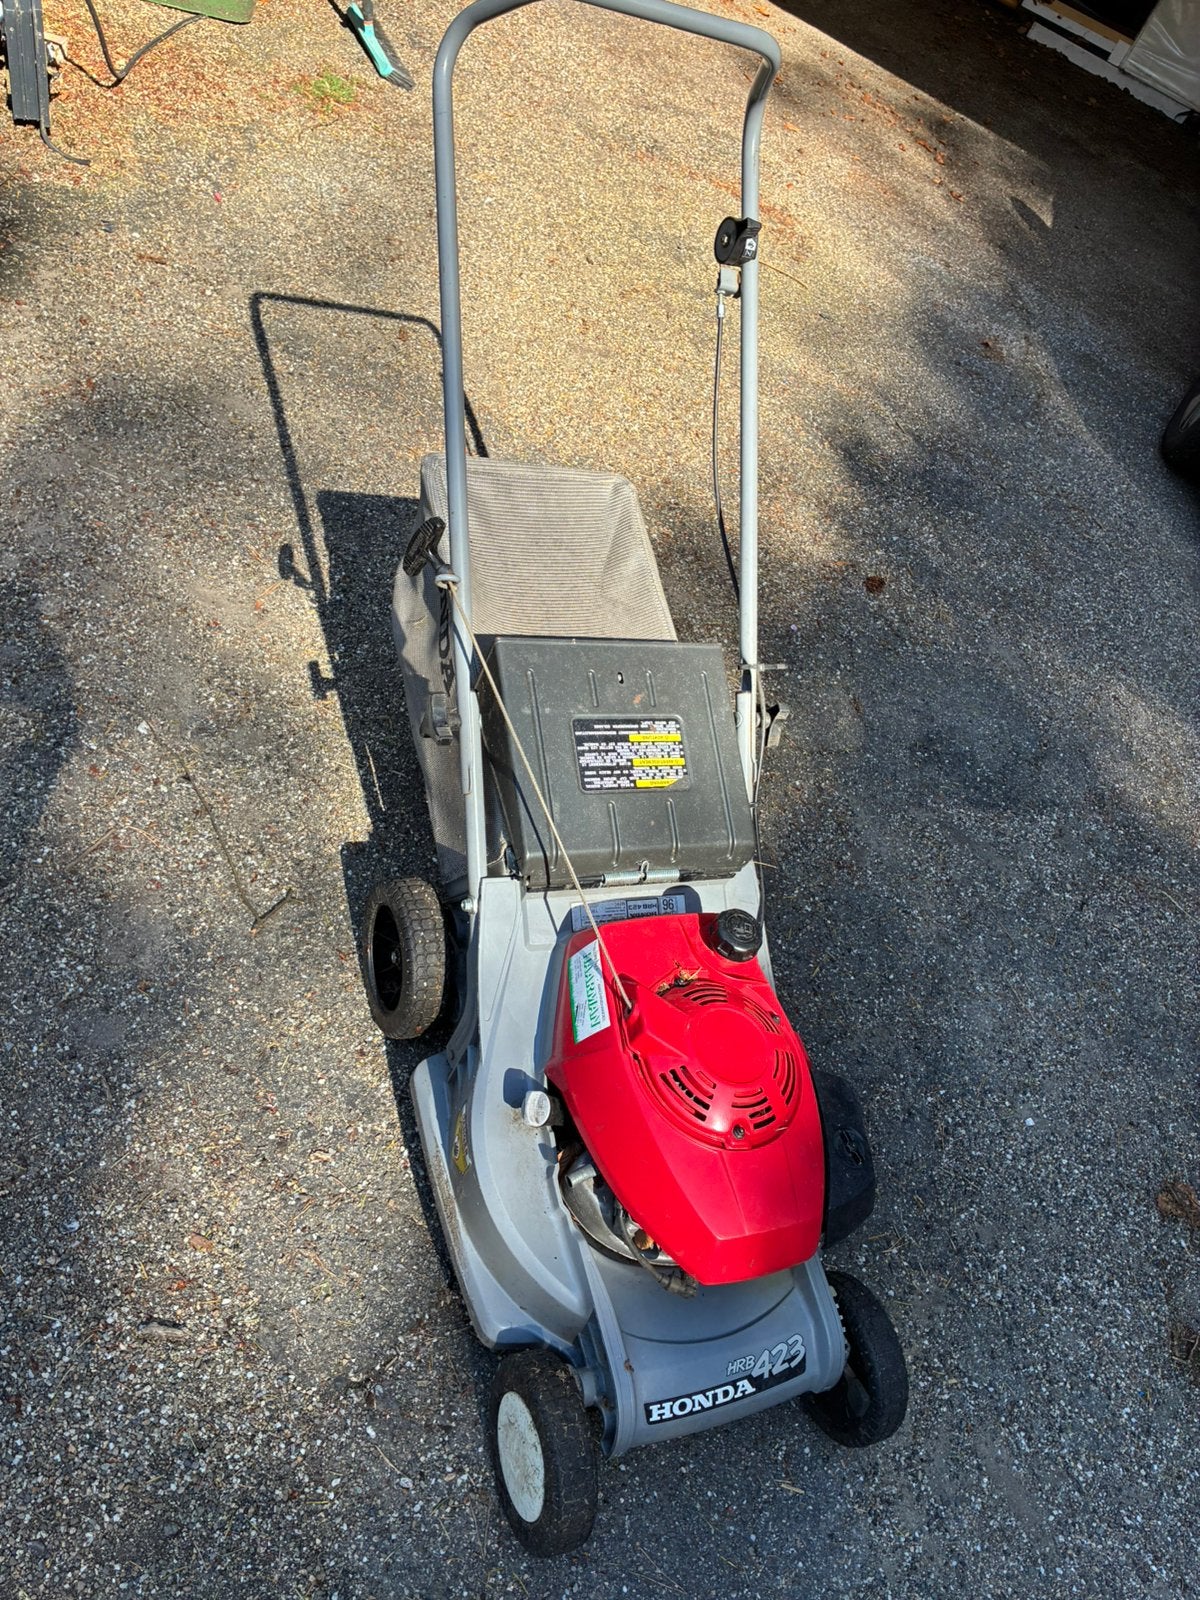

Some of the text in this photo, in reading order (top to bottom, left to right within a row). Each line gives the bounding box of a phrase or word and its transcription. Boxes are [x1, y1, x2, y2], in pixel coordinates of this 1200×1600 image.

[662, 898, 674, 911] 96
[583, 952, 601, 1028] HAARMAN
[649, 1379, 756, 1422] HONDA
